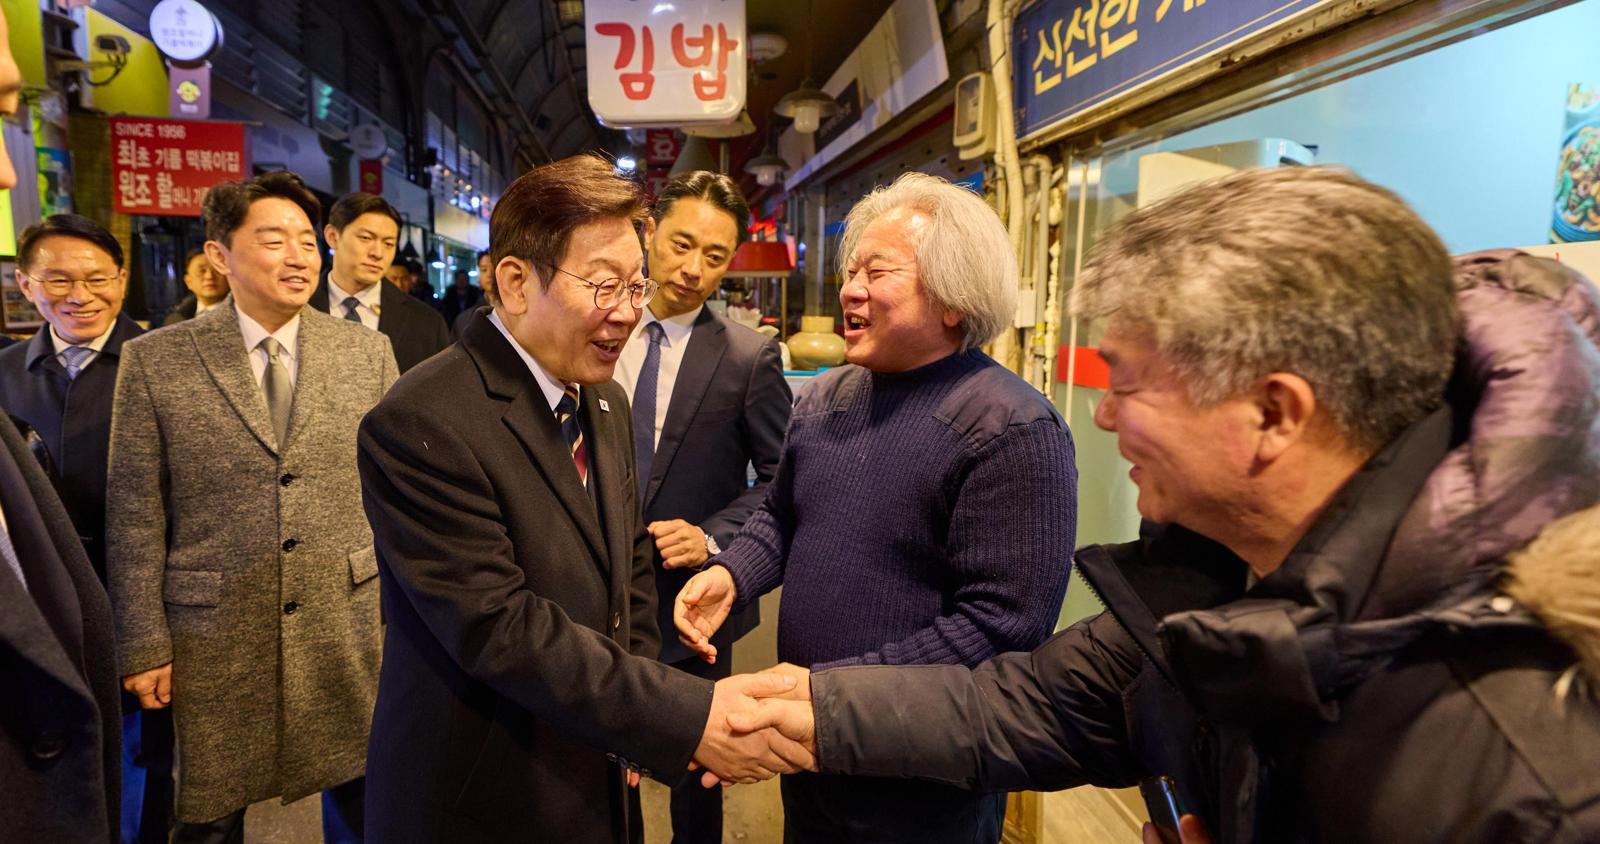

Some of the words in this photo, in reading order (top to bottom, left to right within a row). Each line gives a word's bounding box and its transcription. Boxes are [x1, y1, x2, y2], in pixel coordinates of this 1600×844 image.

[594, 22, 738, 101] 김밥
[115, 122, 154, 138] SINCE
[117, 139, 151, 169] 최초
[155, 148, 182, 170] 기름
[185, 149, 240, 173] 떡볶이집
[119, 170, 152, 207] 원조
